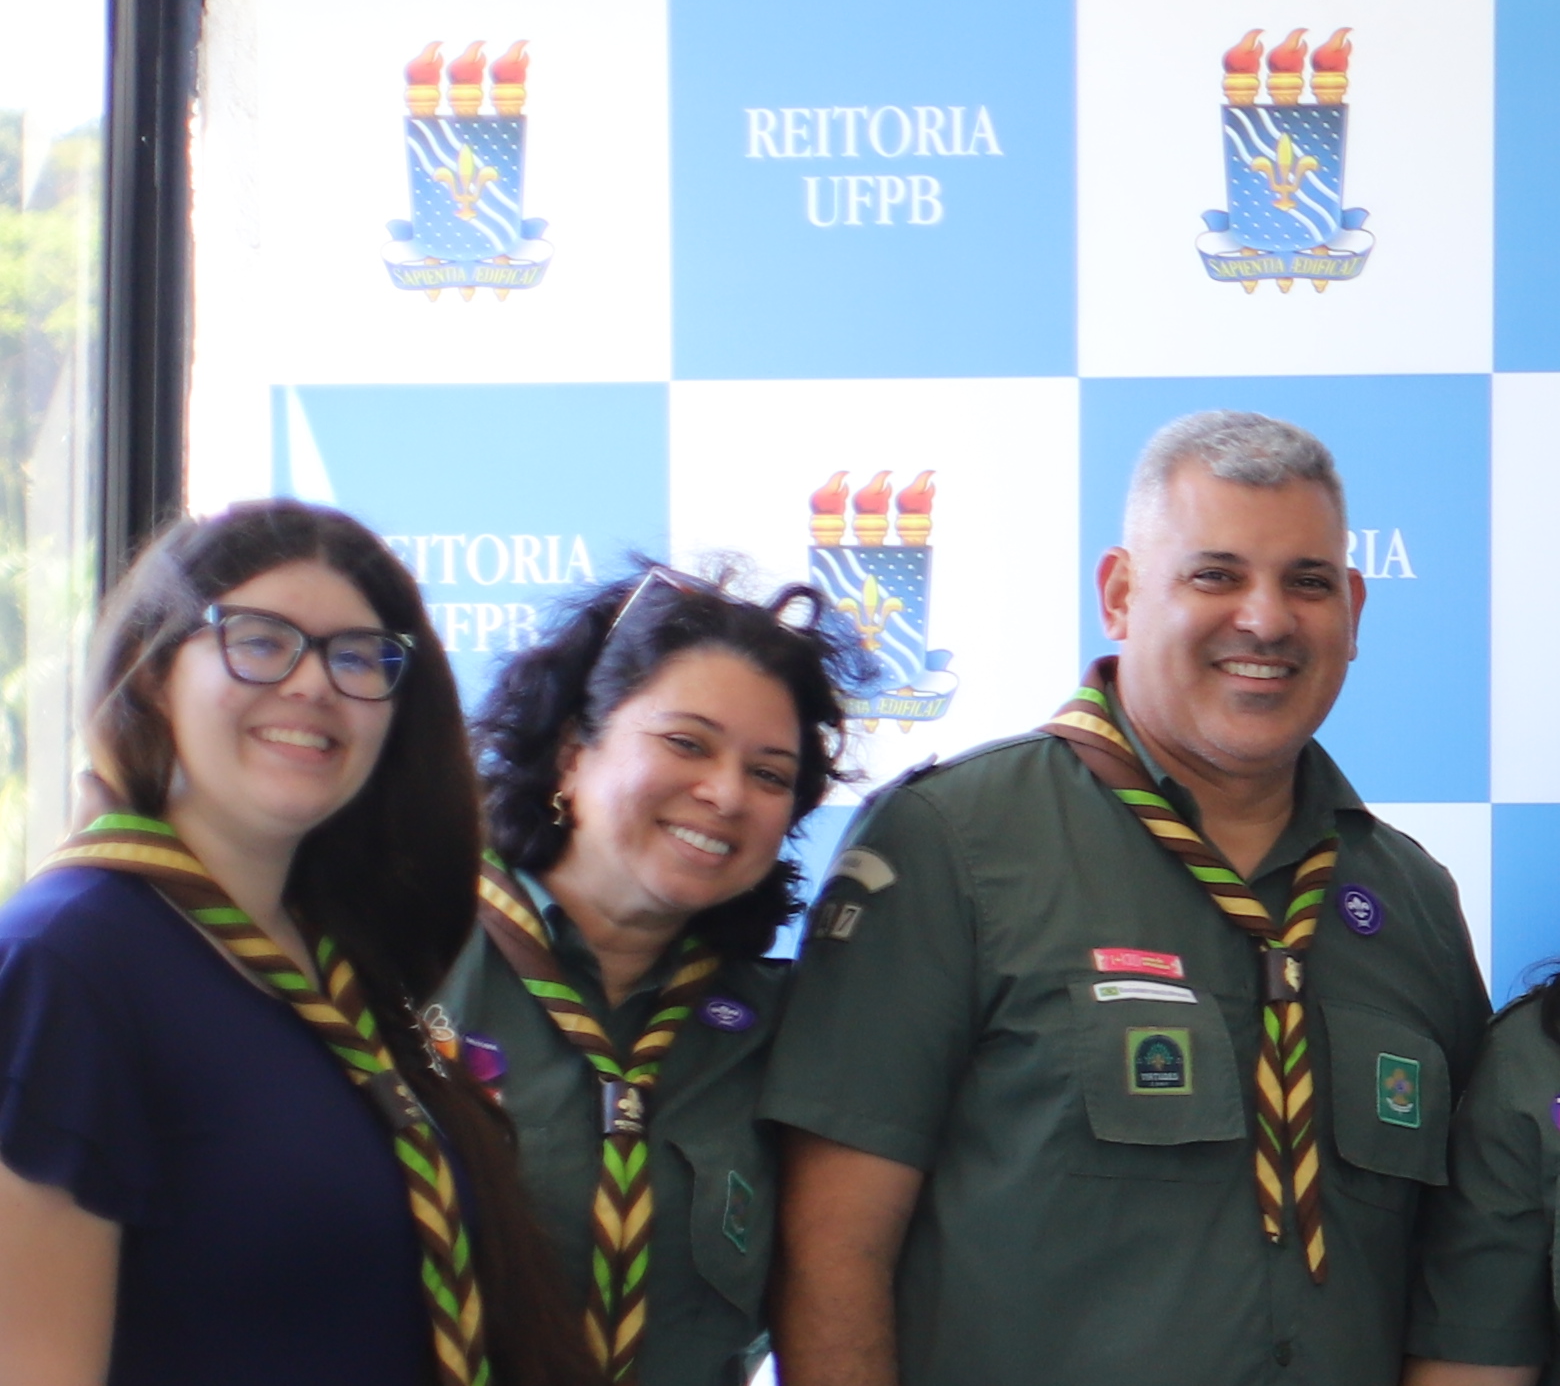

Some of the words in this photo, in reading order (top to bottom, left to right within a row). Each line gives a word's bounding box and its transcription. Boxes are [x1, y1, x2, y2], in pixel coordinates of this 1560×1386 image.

[744, 104, 1004, 158] REITORIA
[802, 174, 944, 227] UFPB
[382, 533, 600, 586] ITORIA
